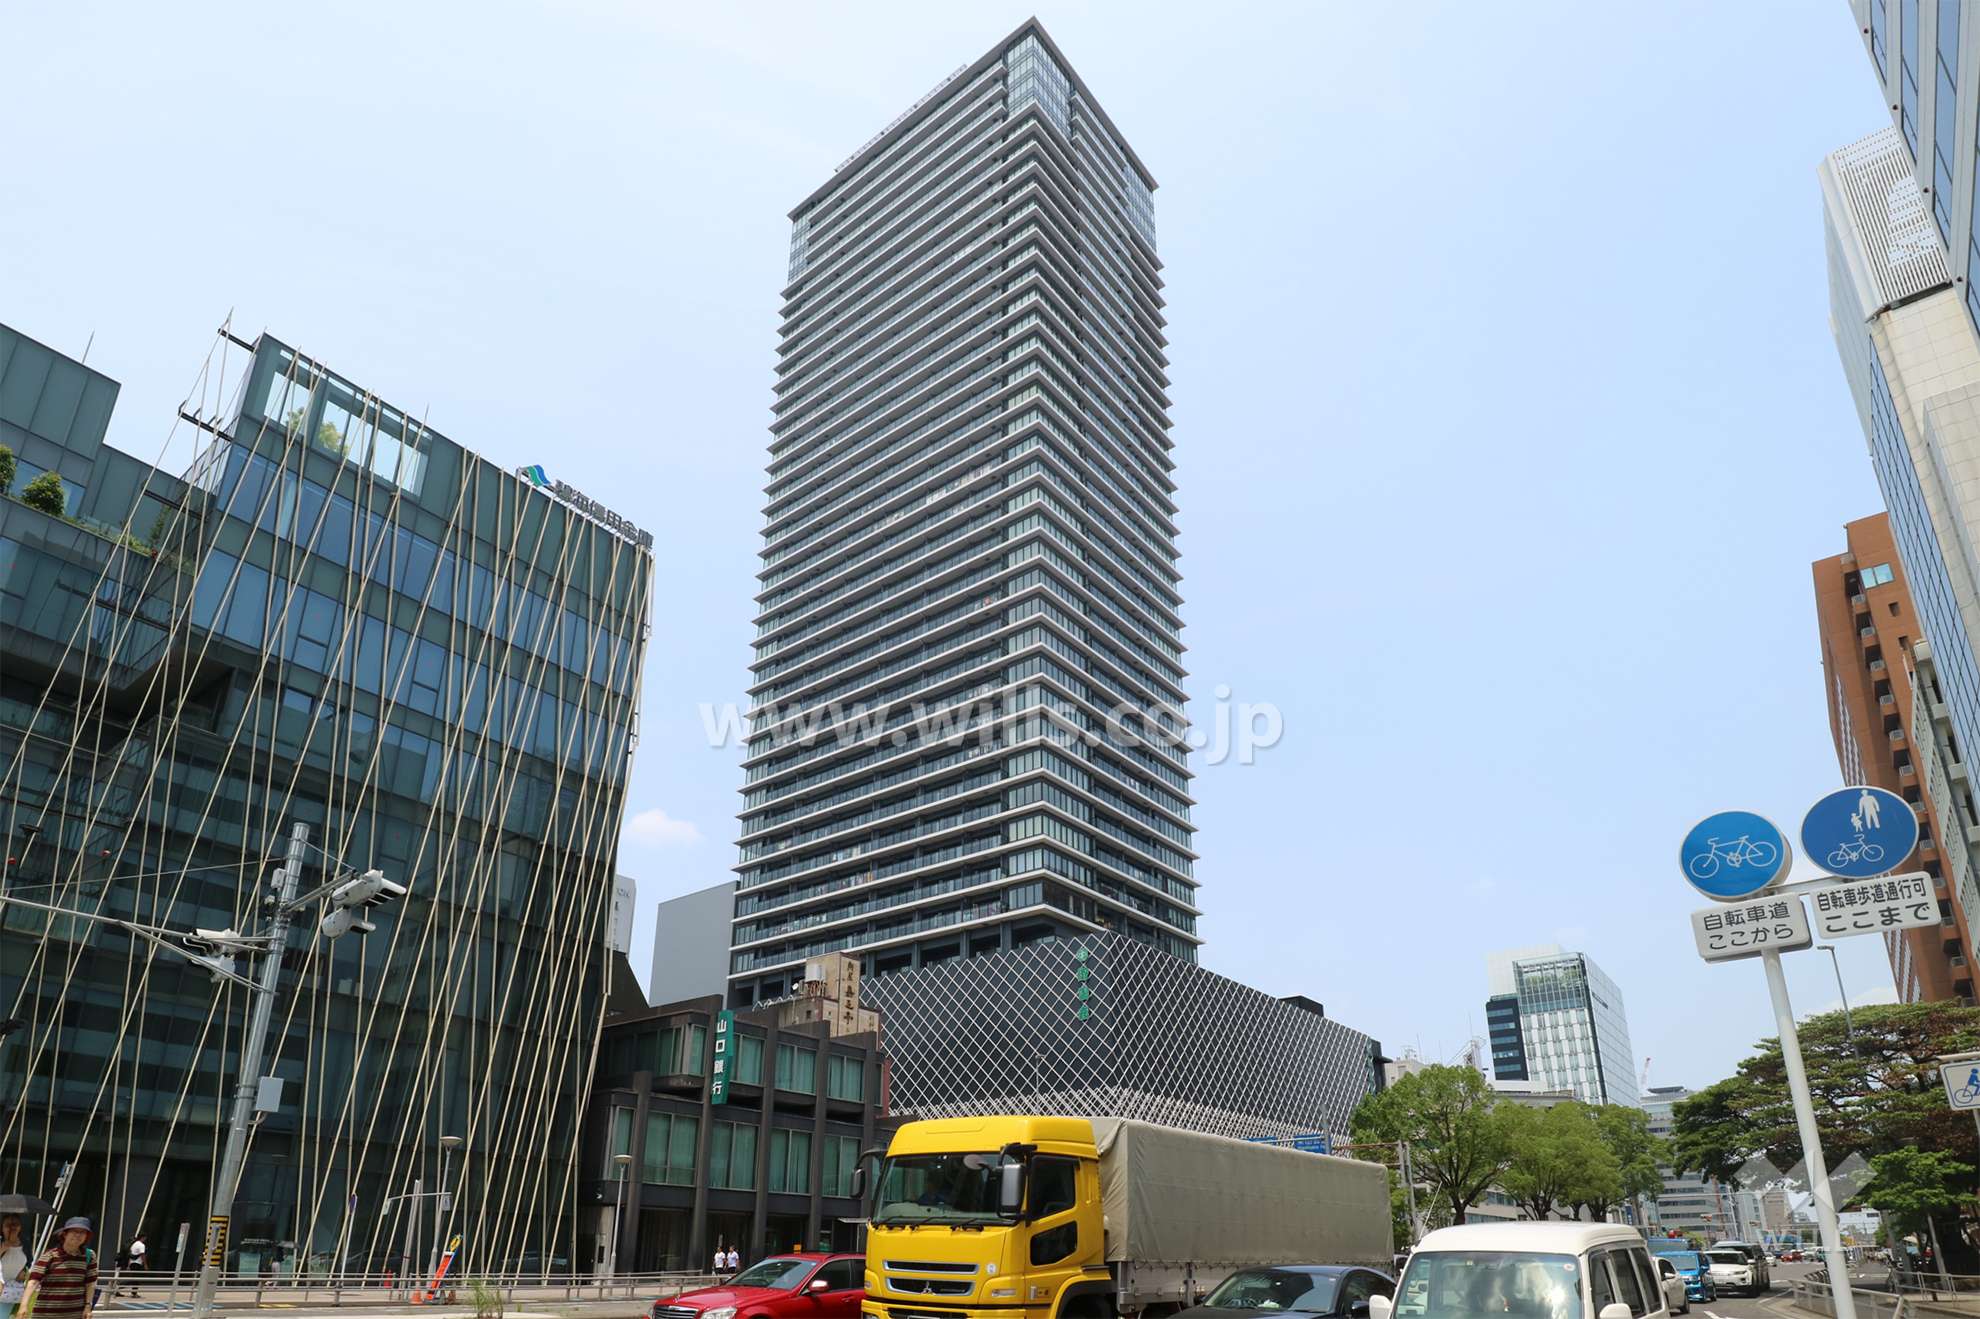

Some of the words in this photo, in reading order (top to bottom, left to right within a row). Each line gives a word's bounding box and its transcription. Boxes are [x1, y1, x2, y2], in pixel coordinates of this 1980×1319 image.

[1816, 877, 1927, 912] 自転車歩道通行可
[1703, 901, 1791, 931] 自転車道
[1825, 902, 1930, 933] ここまで
[1708, 923, 1794, 950] ここから
[712, 1018, 728, 1096] 山口銀行
